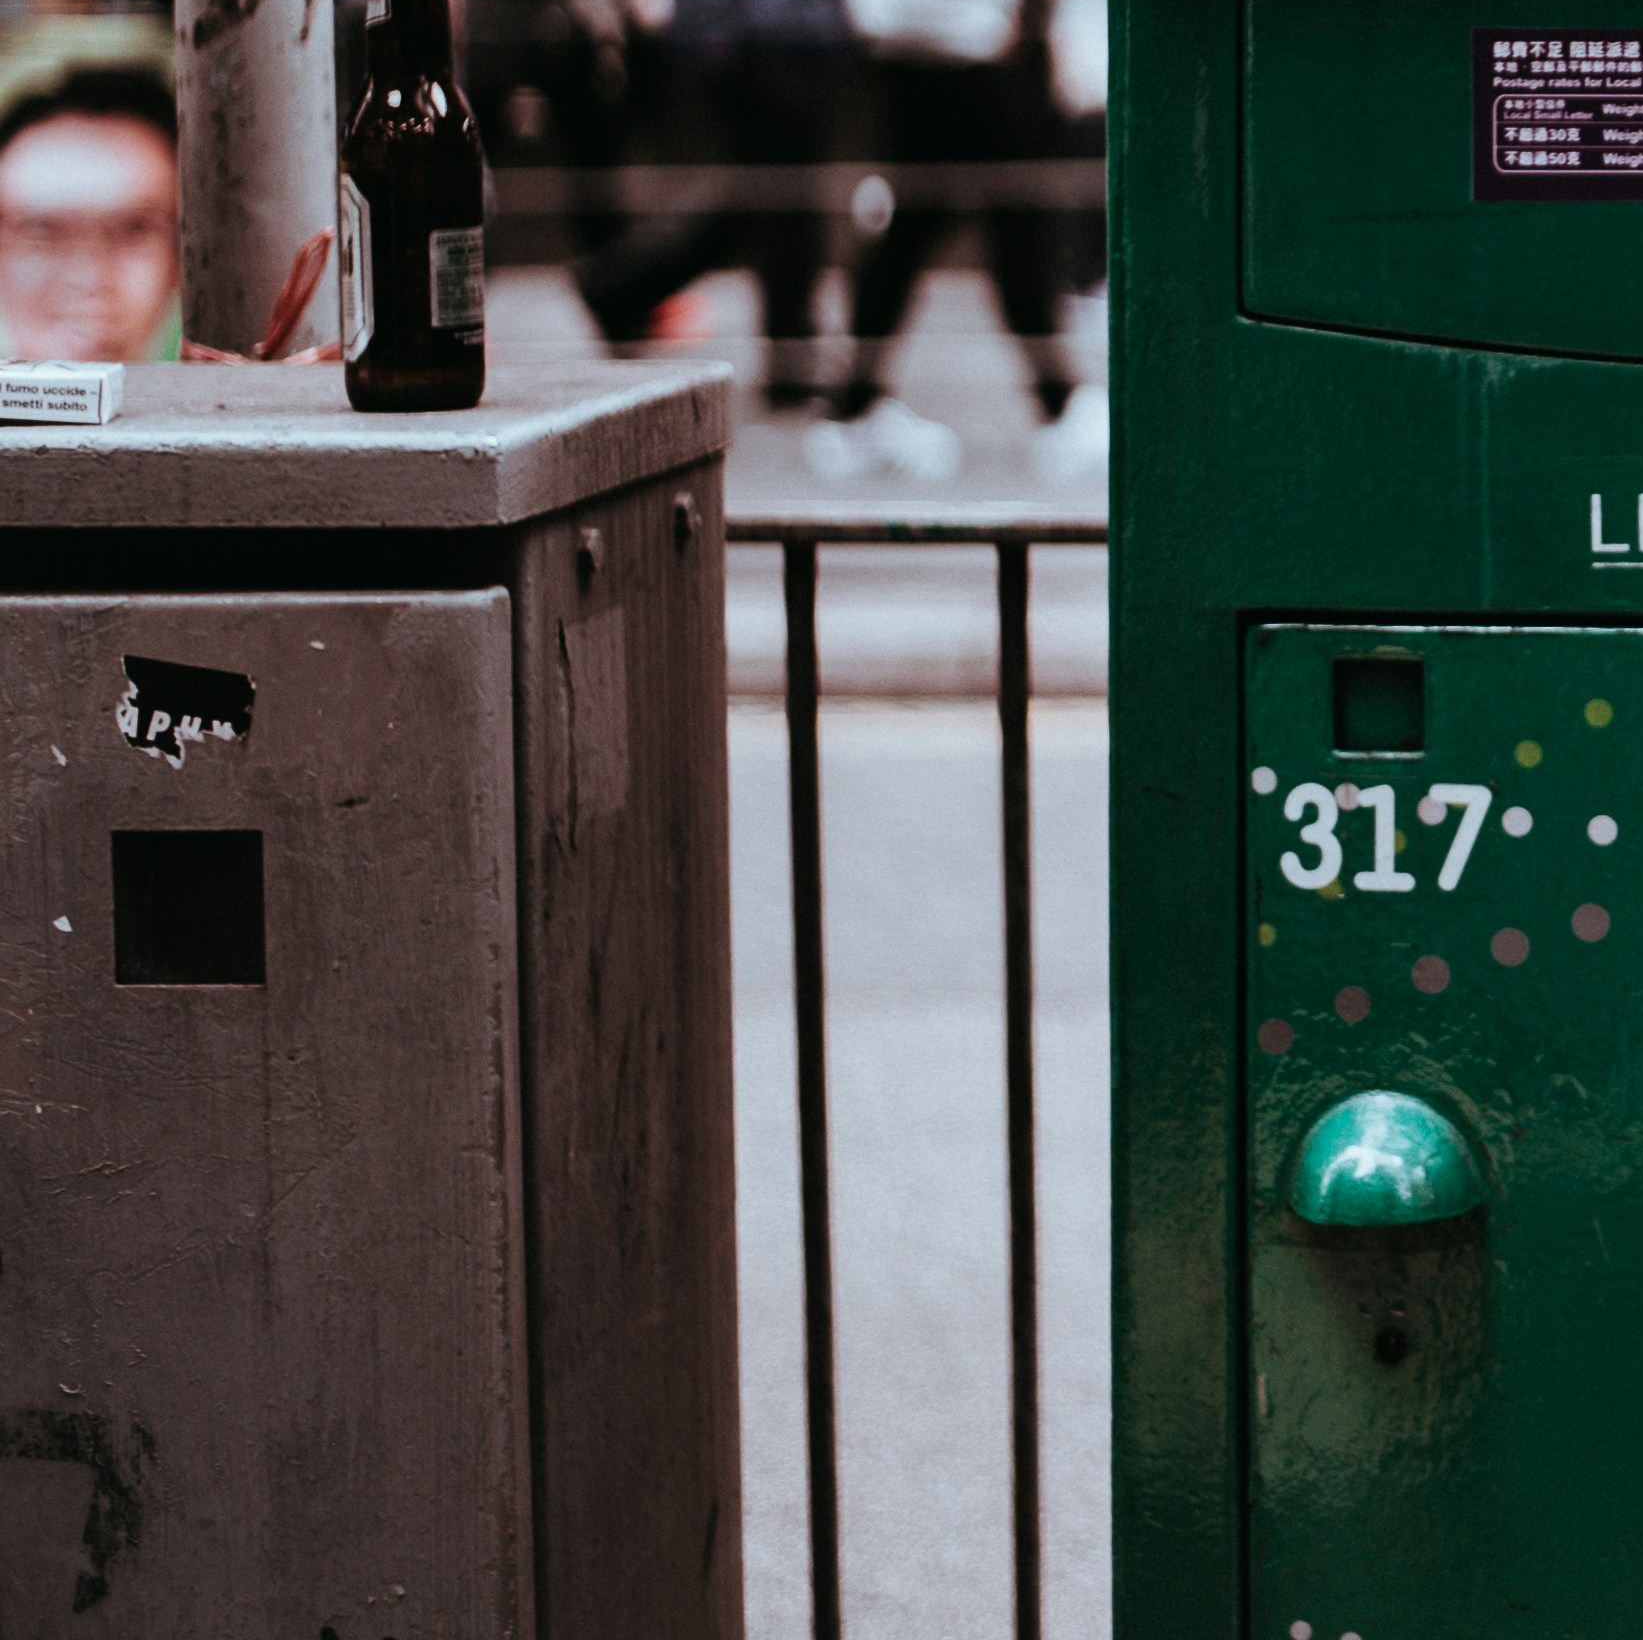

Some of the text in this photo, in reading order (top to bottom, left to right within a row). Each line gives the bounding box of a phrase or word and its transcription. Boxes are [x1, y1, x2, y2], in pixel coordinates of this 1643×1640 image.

[1493, 76, 1545, 89] Postage
[1549, 77, 1581, 87] rates
[1585, 76, 1602, 87] for
[1606, 77, 1641, 87] Local
[1504, 110, 1594, 120] Local Small Letter
[6, 382, 39, 394] fumo
[2, 398, 88, 411] smetti subito
[1280, 782, 1492, 892] 317
